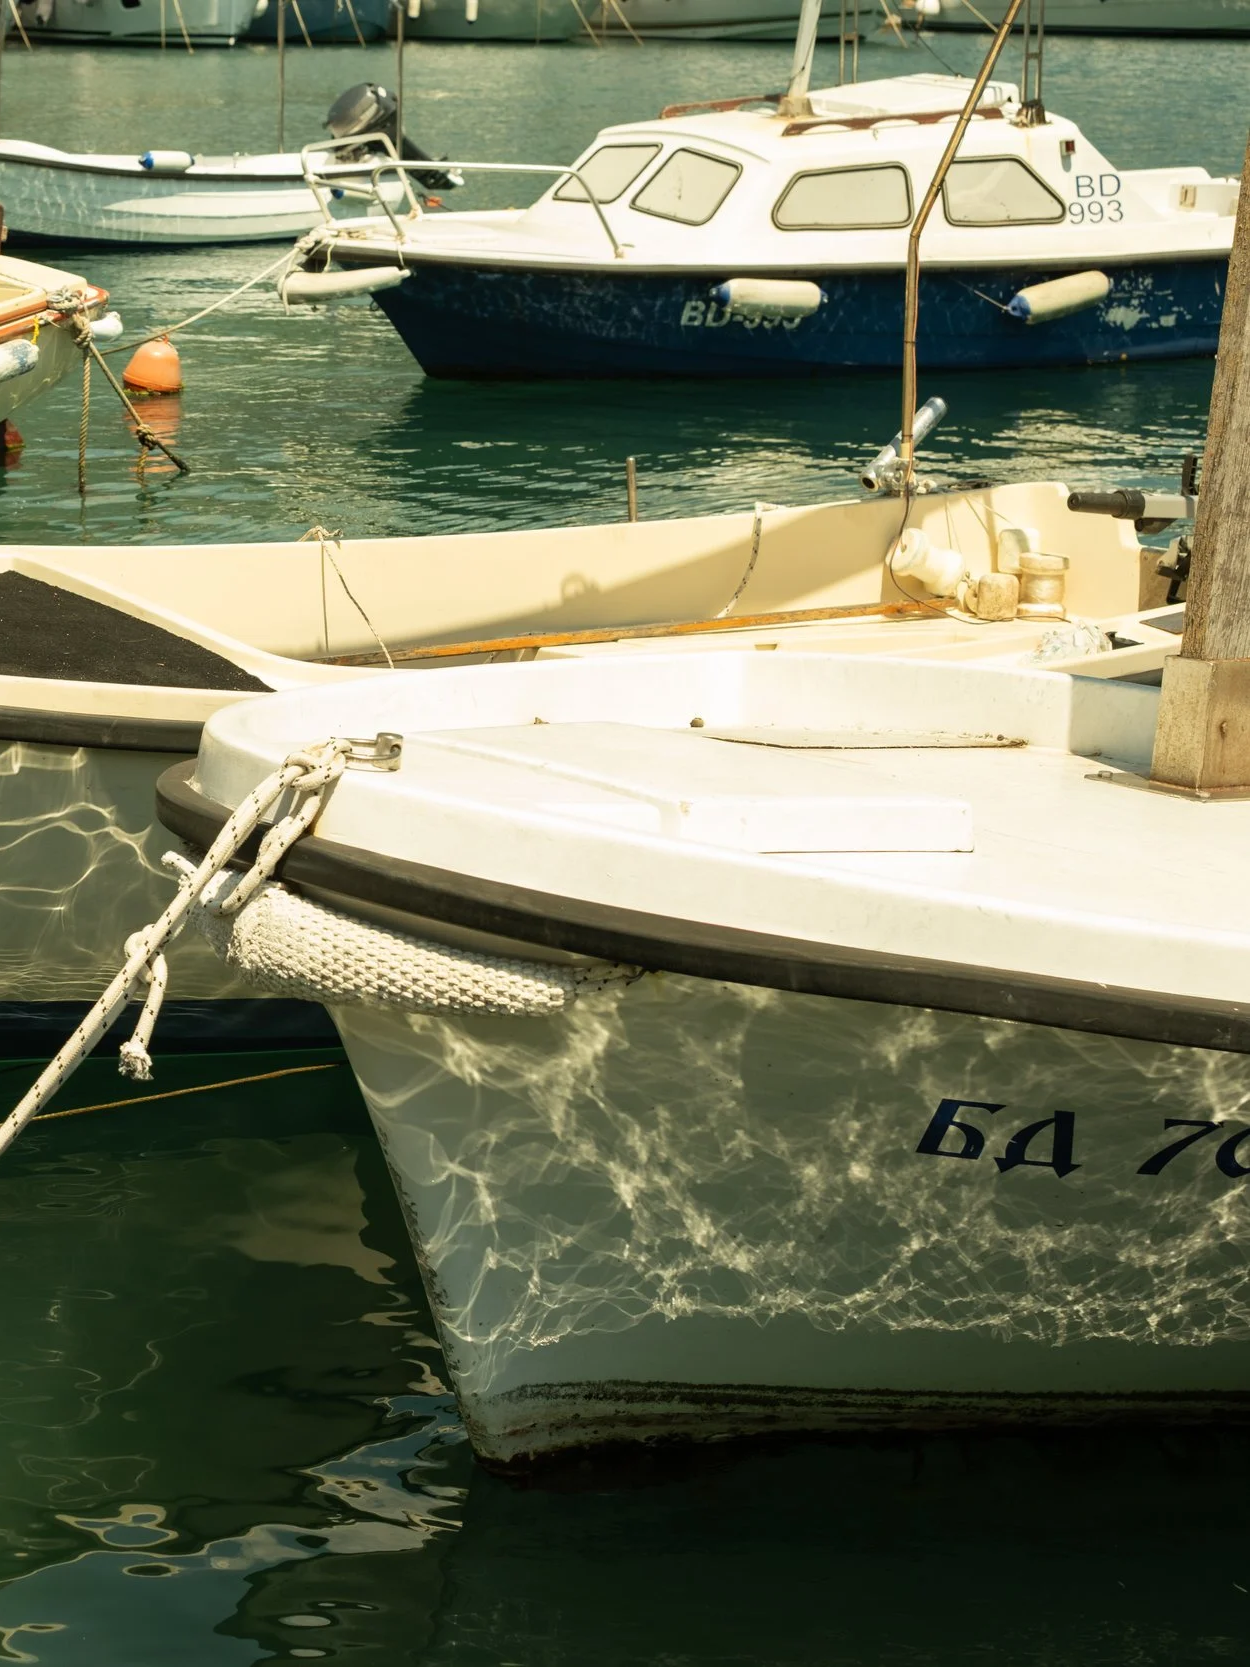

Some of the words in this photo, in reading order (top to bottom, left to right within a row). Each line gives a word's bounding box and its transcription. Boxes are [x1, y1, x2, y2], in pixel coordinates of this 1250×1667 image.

[1076, 173, 1121, 198] BD
[1068, 199, 1124, 225] 993
[915, 1098, 1083, 1179] БД
